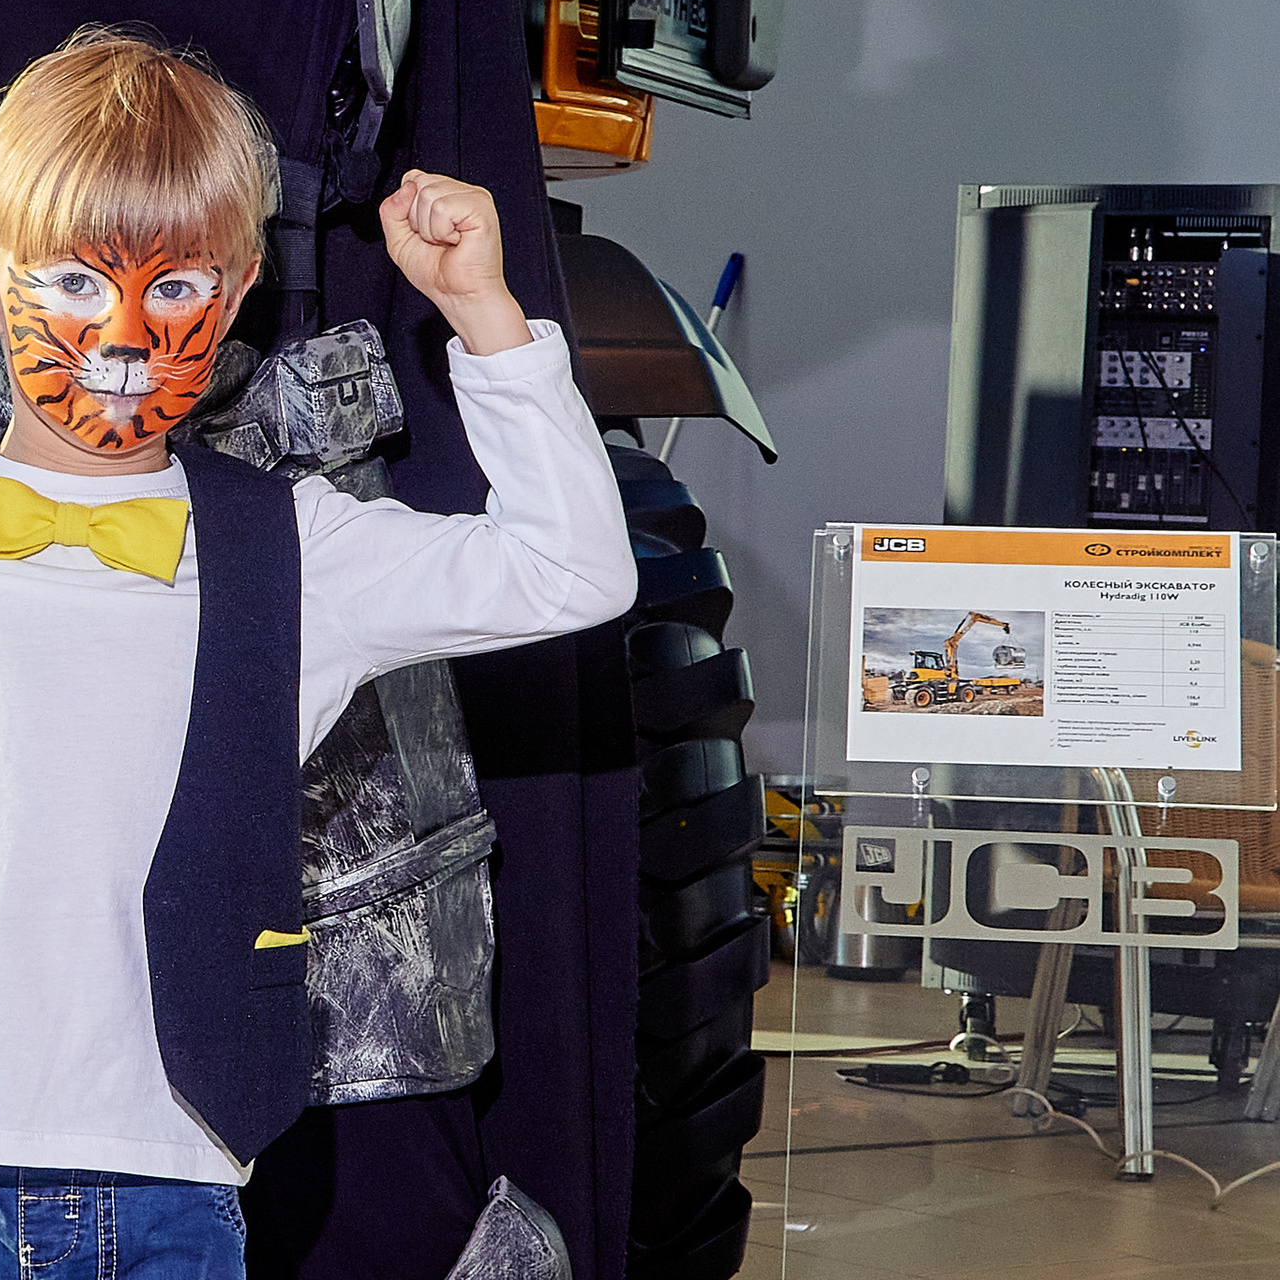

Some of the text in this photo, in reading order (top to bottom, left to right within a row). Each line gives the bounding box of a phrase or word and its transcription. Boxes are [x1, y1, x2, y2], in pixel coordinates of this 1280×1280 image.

[874, 538, 926, 552] JCB
[1116, 547, 1223, 558] СТРОЙКОМПЛЕКТ
[1064, 580, 1216, 591] КОЛЕСНЫЙ ЭКСКАВАТОР
[1100, 592, 1179, 602] Hydradig 110W
[863, 845, 891, 865] JCB
[854, 839, 1227, 936] JCB
